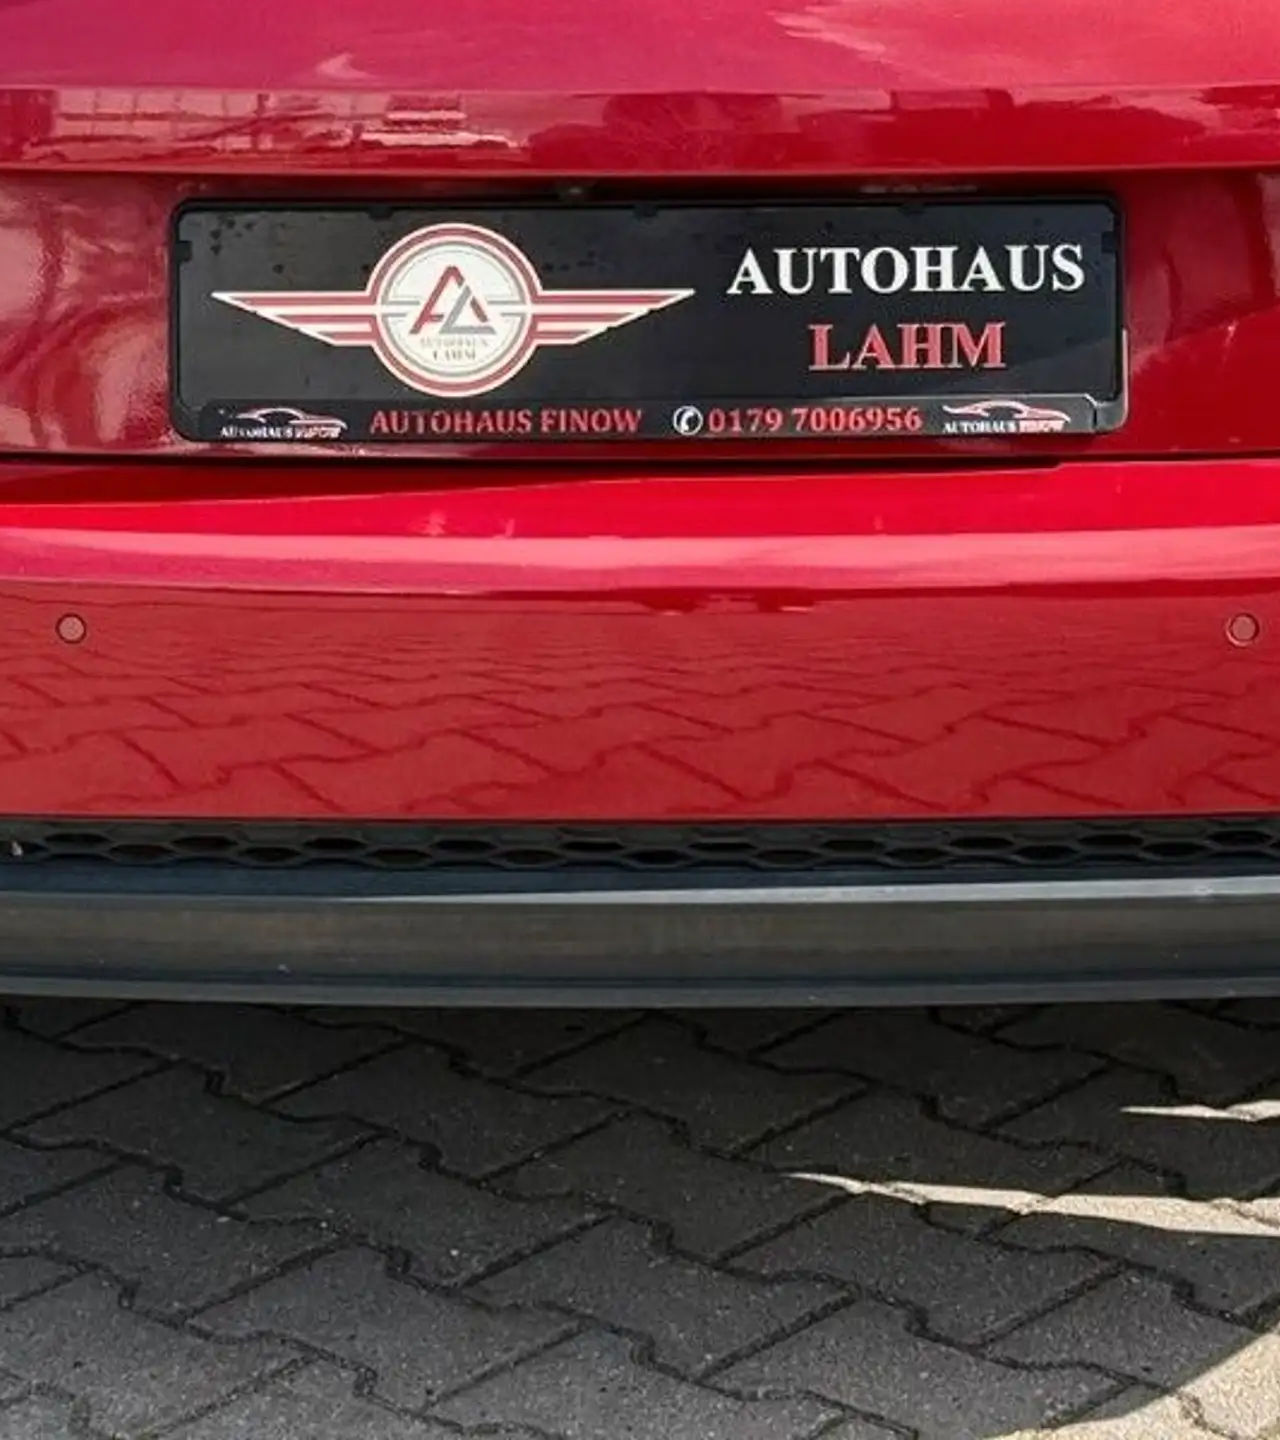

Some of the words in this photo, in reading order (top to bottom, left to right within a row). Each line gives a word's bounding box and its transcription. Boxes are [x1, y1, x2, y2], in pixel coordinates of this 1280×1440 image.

[726, 244, 1086, 295] AUTOHAUS
[807, 321, 1007, 372] LAHM
[369, 409, 532, 434] AUTOHAUS
[540, 408, 643, 433] FINOW
[708, 408, 784, 433] 0179
[791, 406, 922, 432] 7006956
